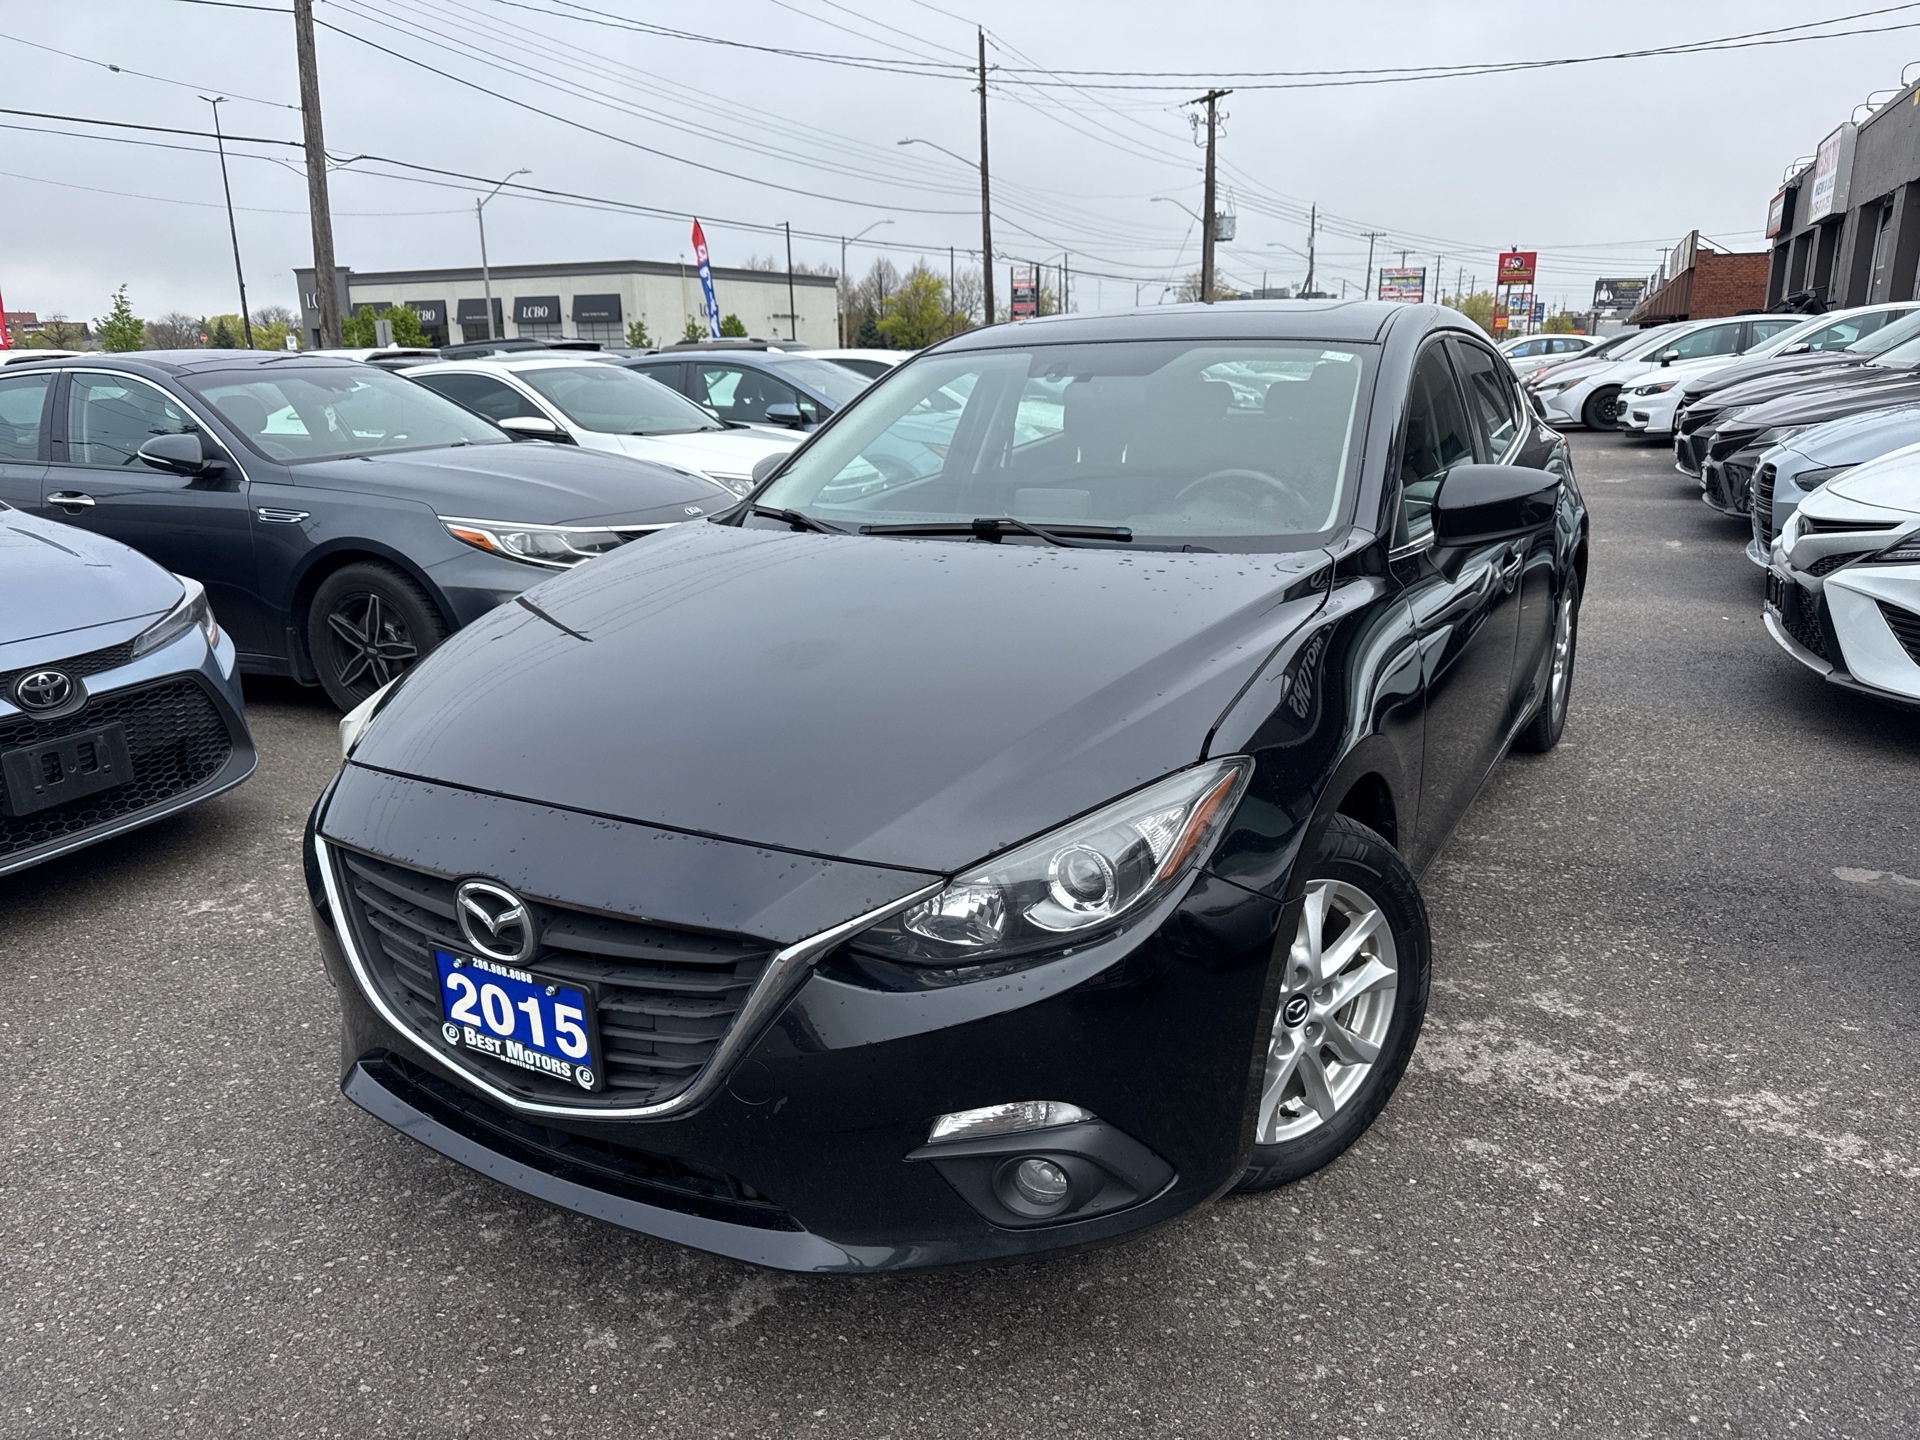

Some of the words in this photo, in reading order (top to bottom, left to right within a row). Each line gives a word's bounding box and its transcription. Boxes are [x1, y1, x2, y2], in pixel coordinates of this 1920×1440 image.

[522, 305, 549, 319] LCBO
[472, 957, 533, 984] 289.988.8088
[446, 972, 588, 1059] 2015
[500, 1054, 536, 1072] Hamilton
